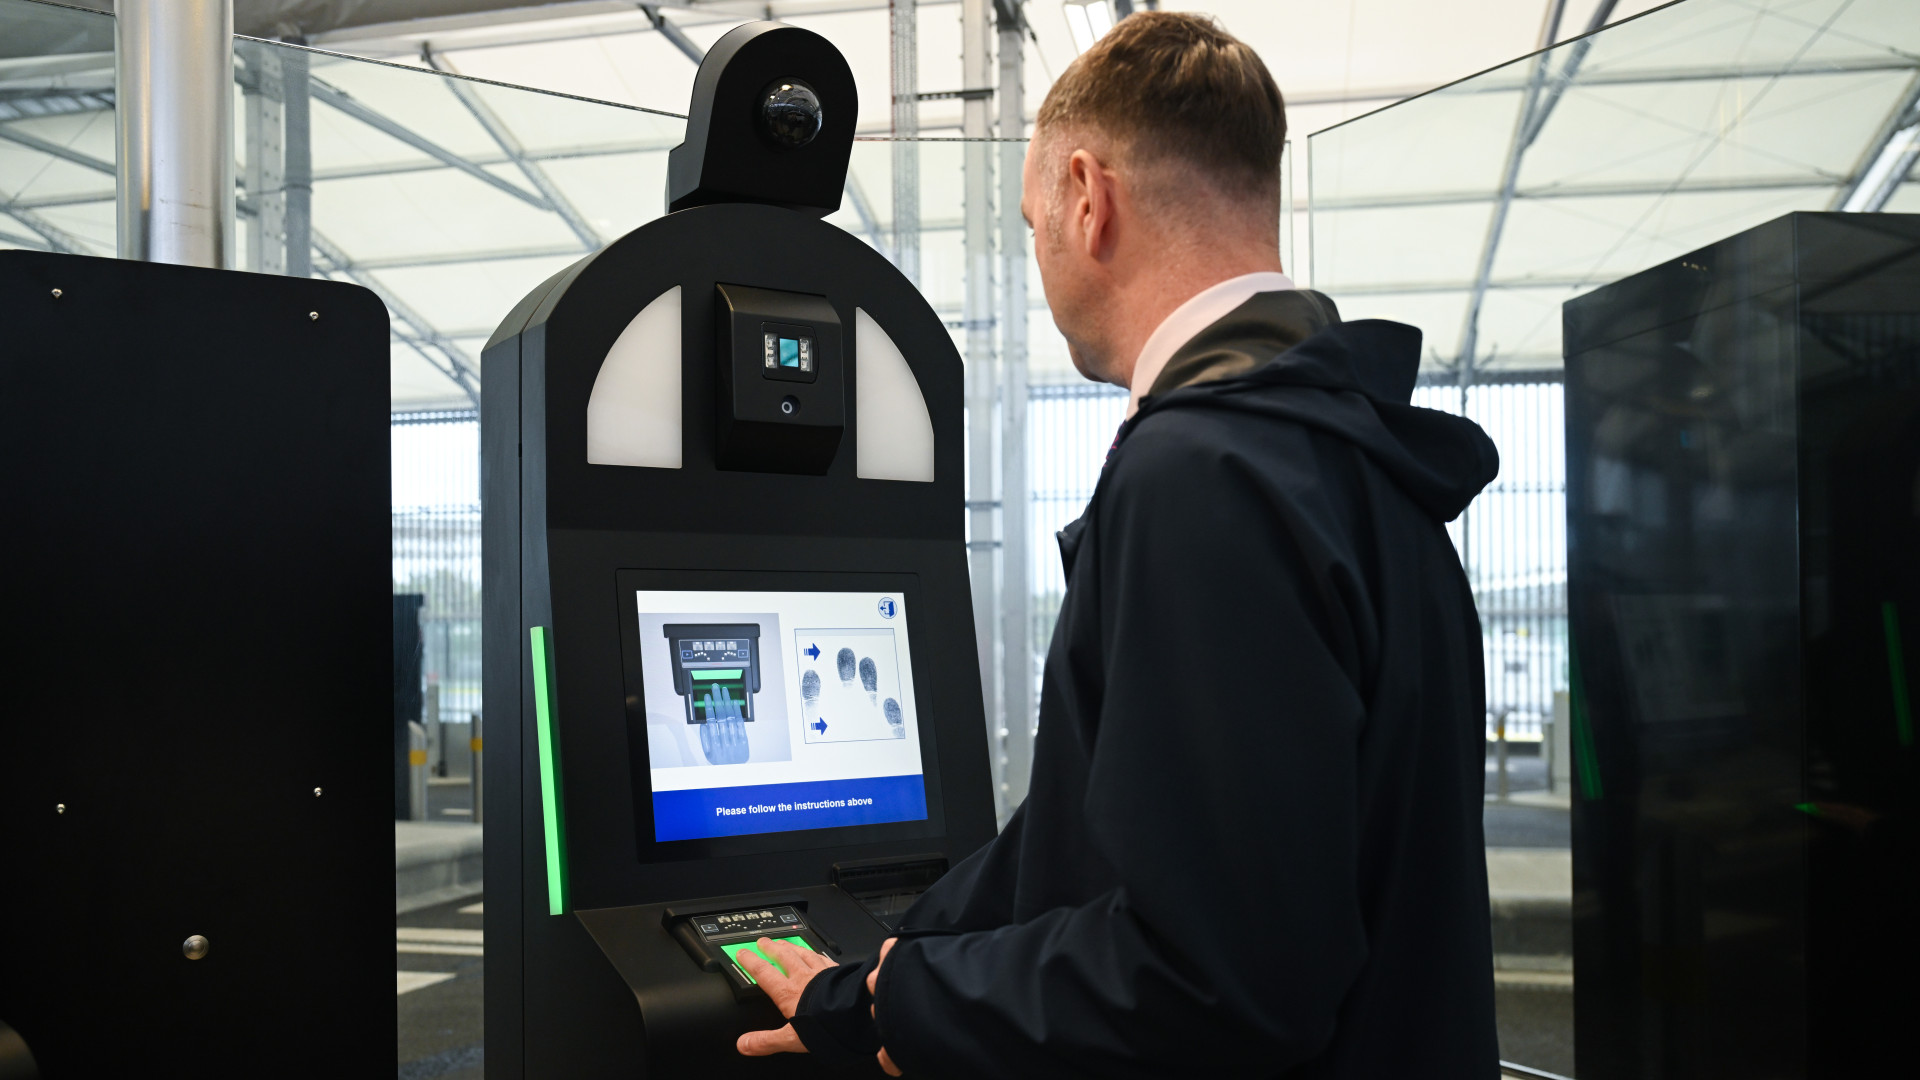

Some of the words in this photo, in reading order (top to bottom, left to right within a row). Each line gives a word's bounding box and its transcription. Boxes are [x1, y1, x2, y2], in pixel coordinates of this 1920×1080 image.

[716, 807, 747, 816] Please
[749, 805, 776, 814] follow
[778, 803, 792, 811] the
[794, 800, 845, 810] instructions
[848, 798, 872, 806] above
